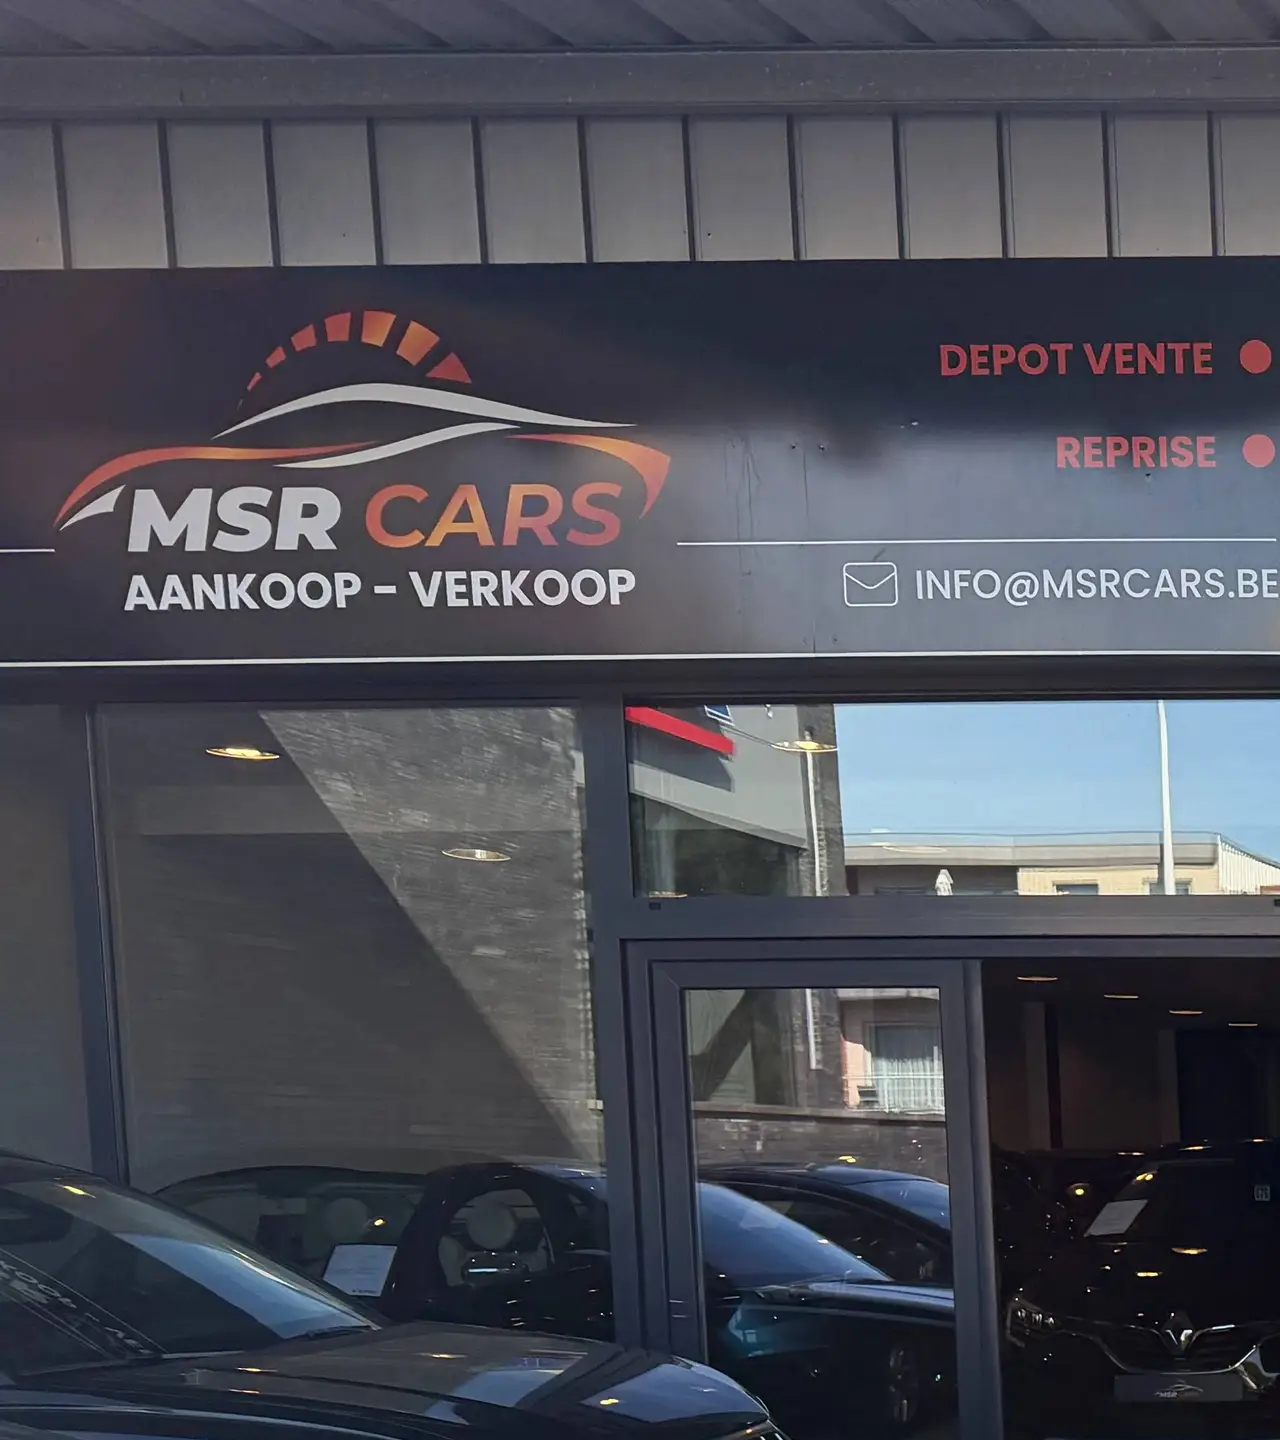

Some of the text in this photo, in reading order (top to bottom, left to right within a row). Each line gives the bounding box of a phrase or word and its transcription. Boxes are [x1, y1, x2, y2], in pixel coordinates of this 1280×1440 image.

[940, 342, 1213, 377] DEPOT VENTE
[1056, 436, 1217, 469] REPRISE
[127, 482, 623, 553] MSR CARS
[124, 572, 362, 611] AANKOOP
[408, 568, 637, 607] VERKOOP
[915, 567, 1280, 606] INFO@MSRCARS.BE
